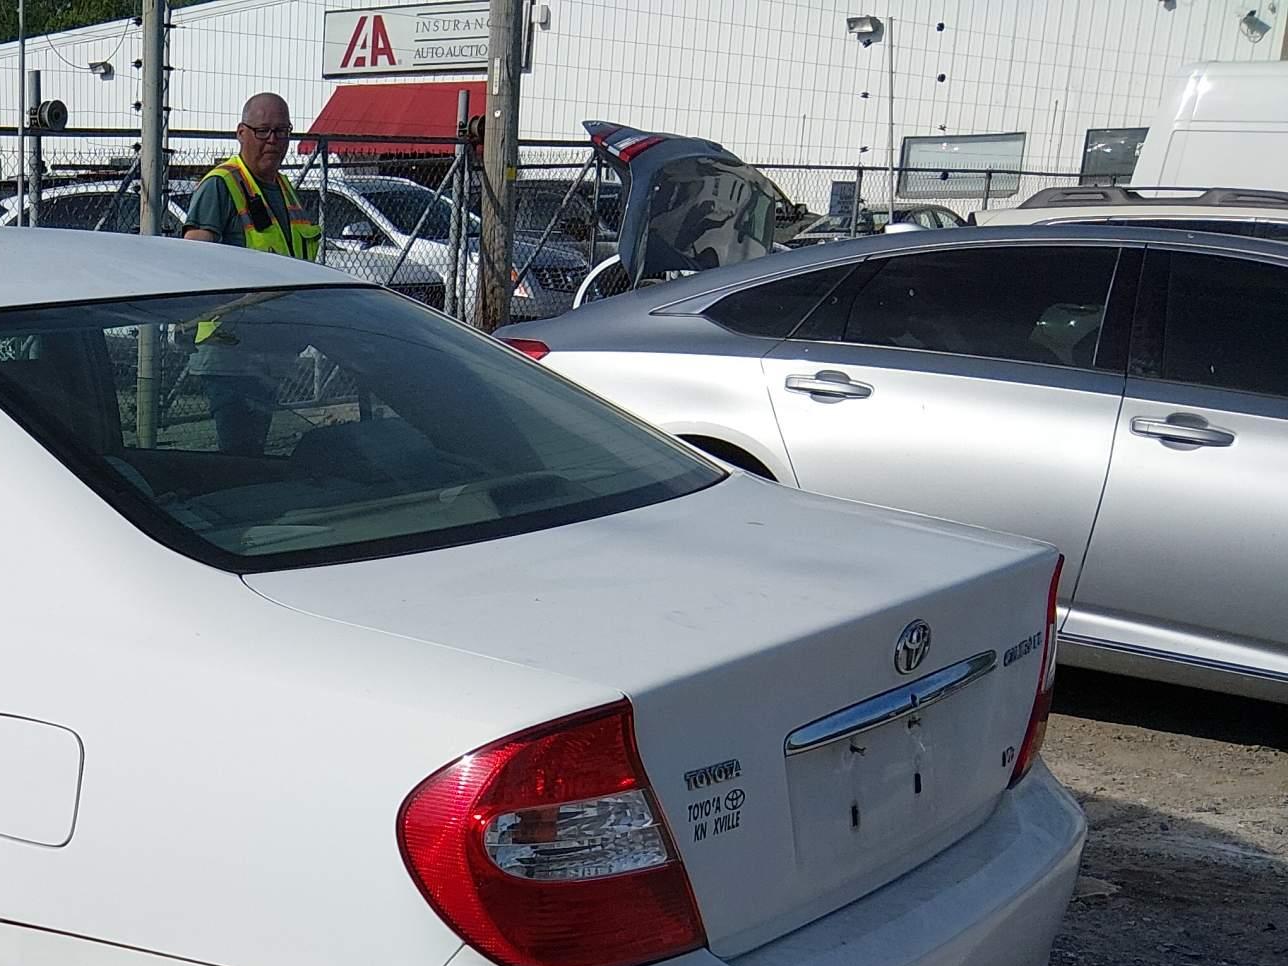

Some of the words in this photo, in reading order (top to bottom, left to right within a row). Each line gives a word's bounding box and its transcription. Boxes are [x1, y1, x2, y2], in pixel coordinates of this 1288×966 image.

[414, 46, 444, 60] AUTO
[446, 44, 488, 58] AUCTIO
[684, 758, 742, 791] TOYOTA
